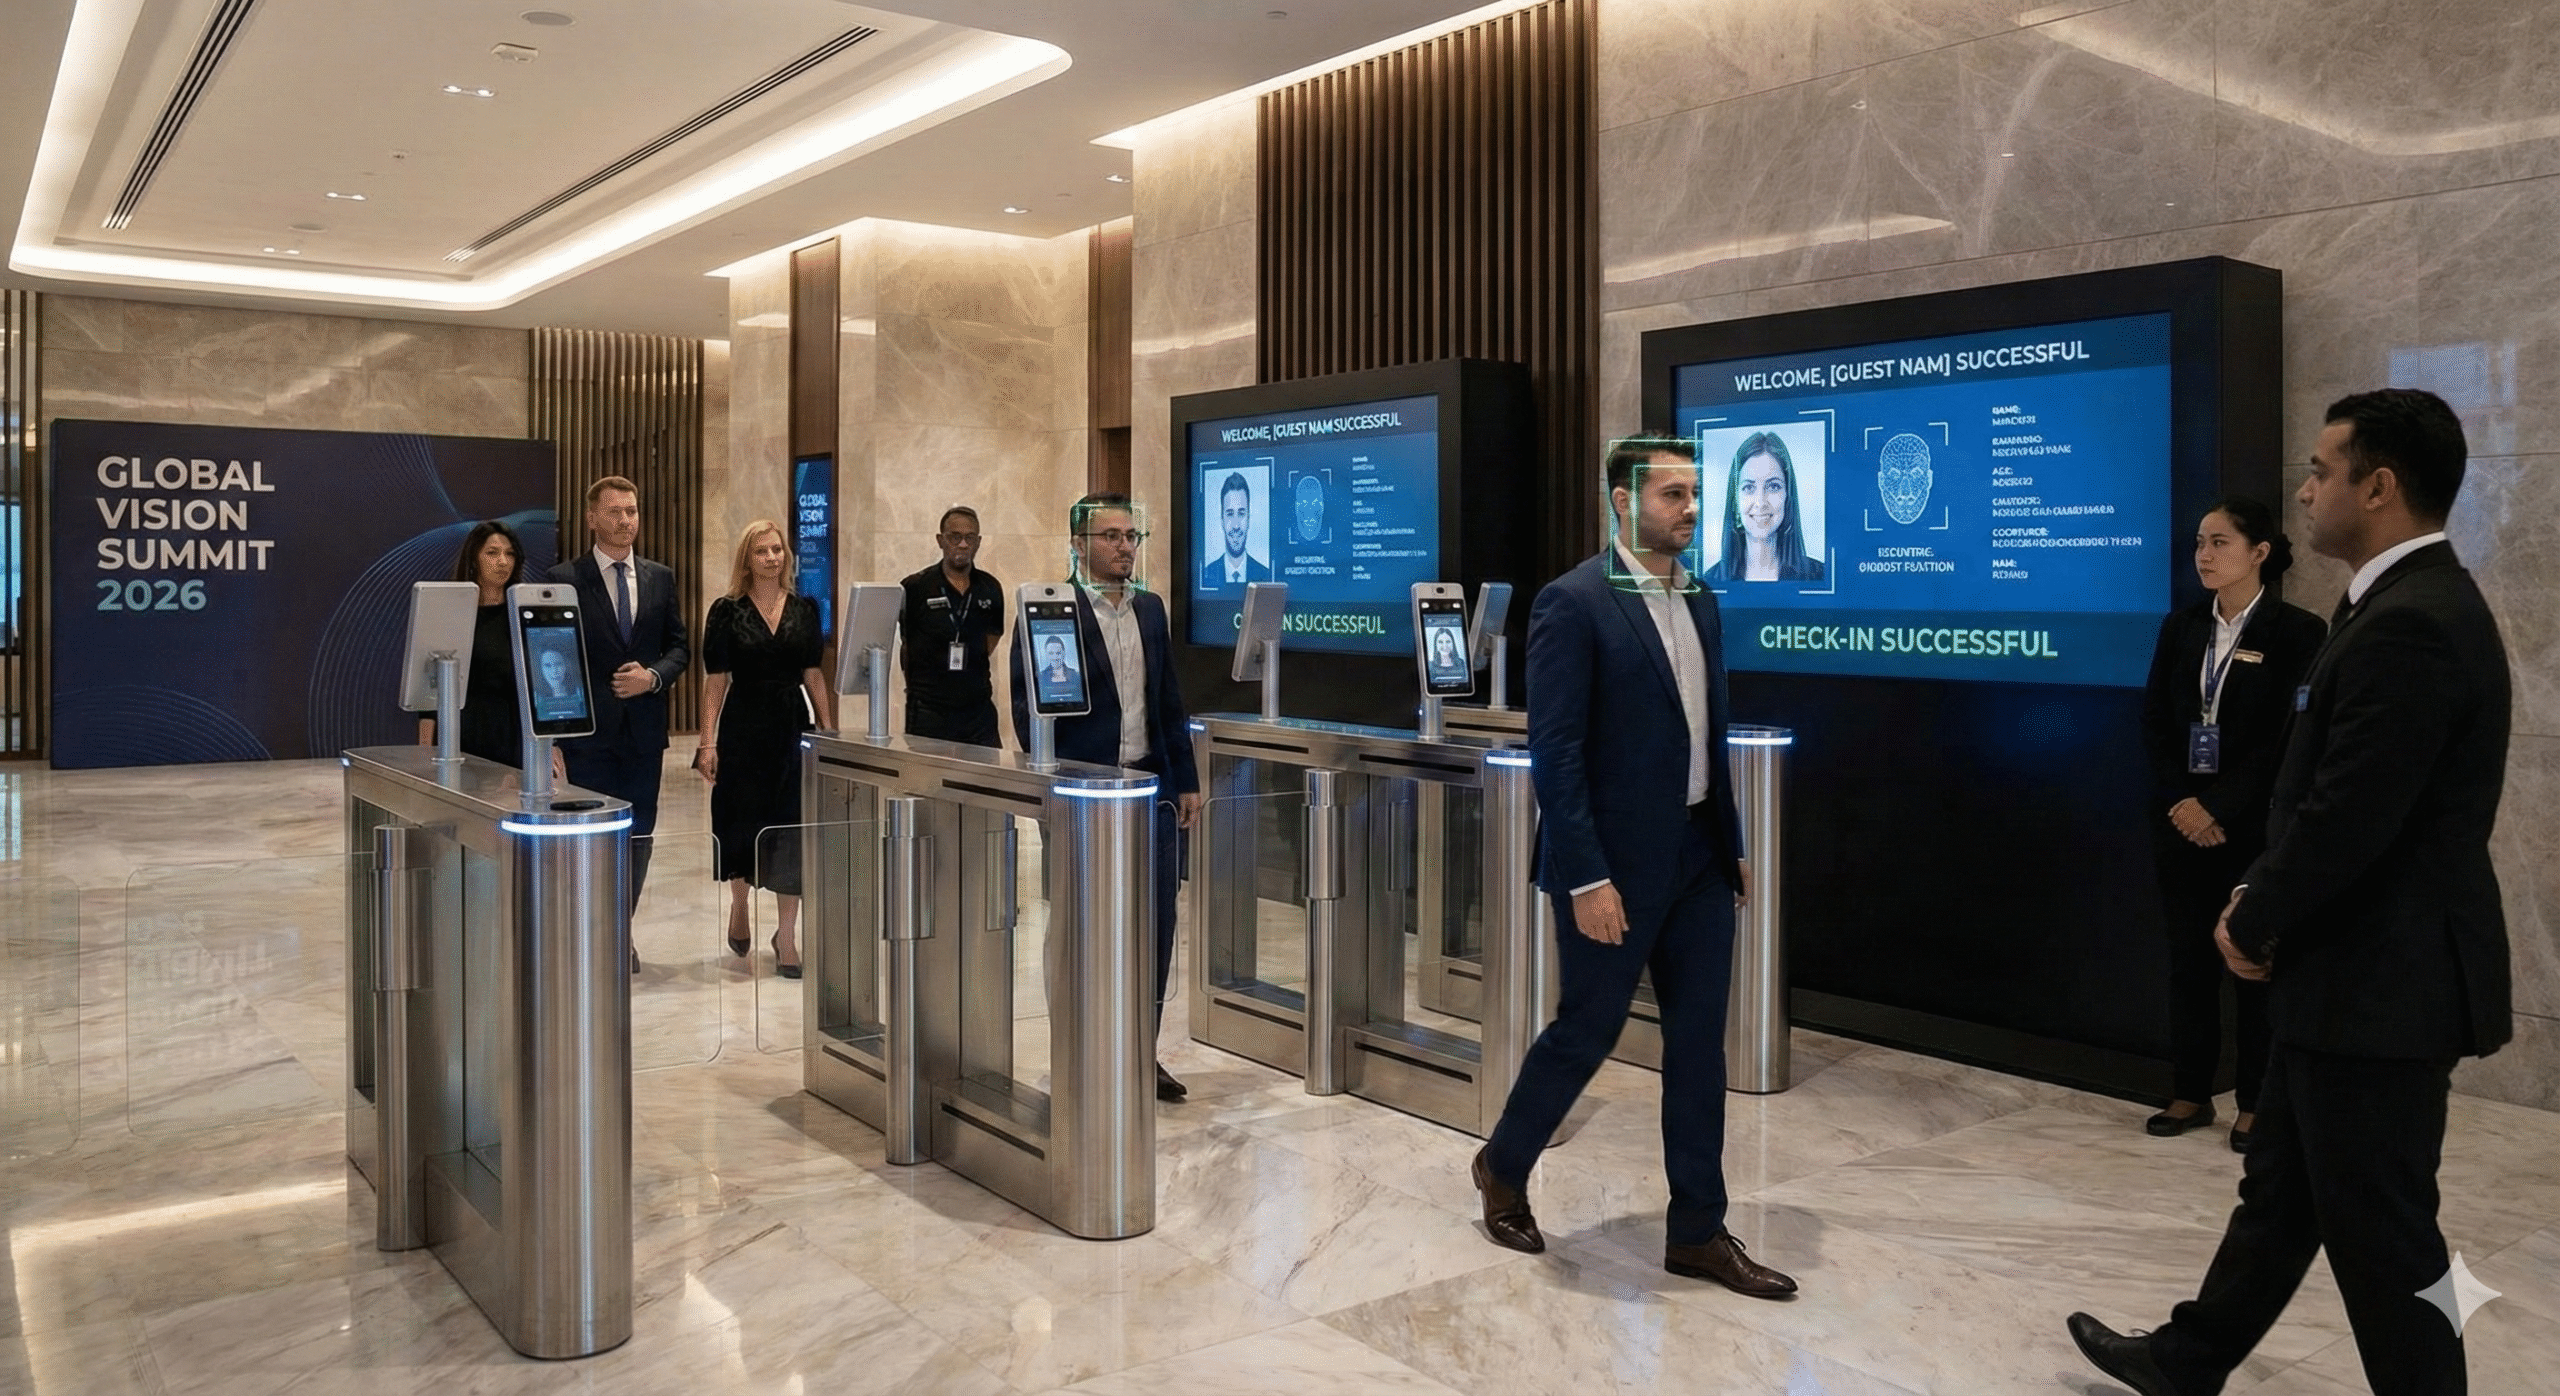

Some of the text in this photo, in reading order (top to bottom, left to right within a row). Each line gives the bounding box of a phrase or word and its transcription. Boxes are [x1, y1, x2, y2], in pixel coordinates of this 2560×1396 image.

[1735, 341, 2090, 393] WELCOME, [GUEST NAM] SUCCESSFUL
[1333, 411, 1402, 432] SUCCESSFUL
[97, 456, 275, 492] GLOBAL
[96, 497, 247, 531] VISION
[97, 537, 275, 571] SUMMIT
[97, 579, 206, 611] 2026
[1296, 613, 1386, 635] SUCCESSFUL
[1760, 625, 2059, 657] CHECK-IN SUCCESSFUL
